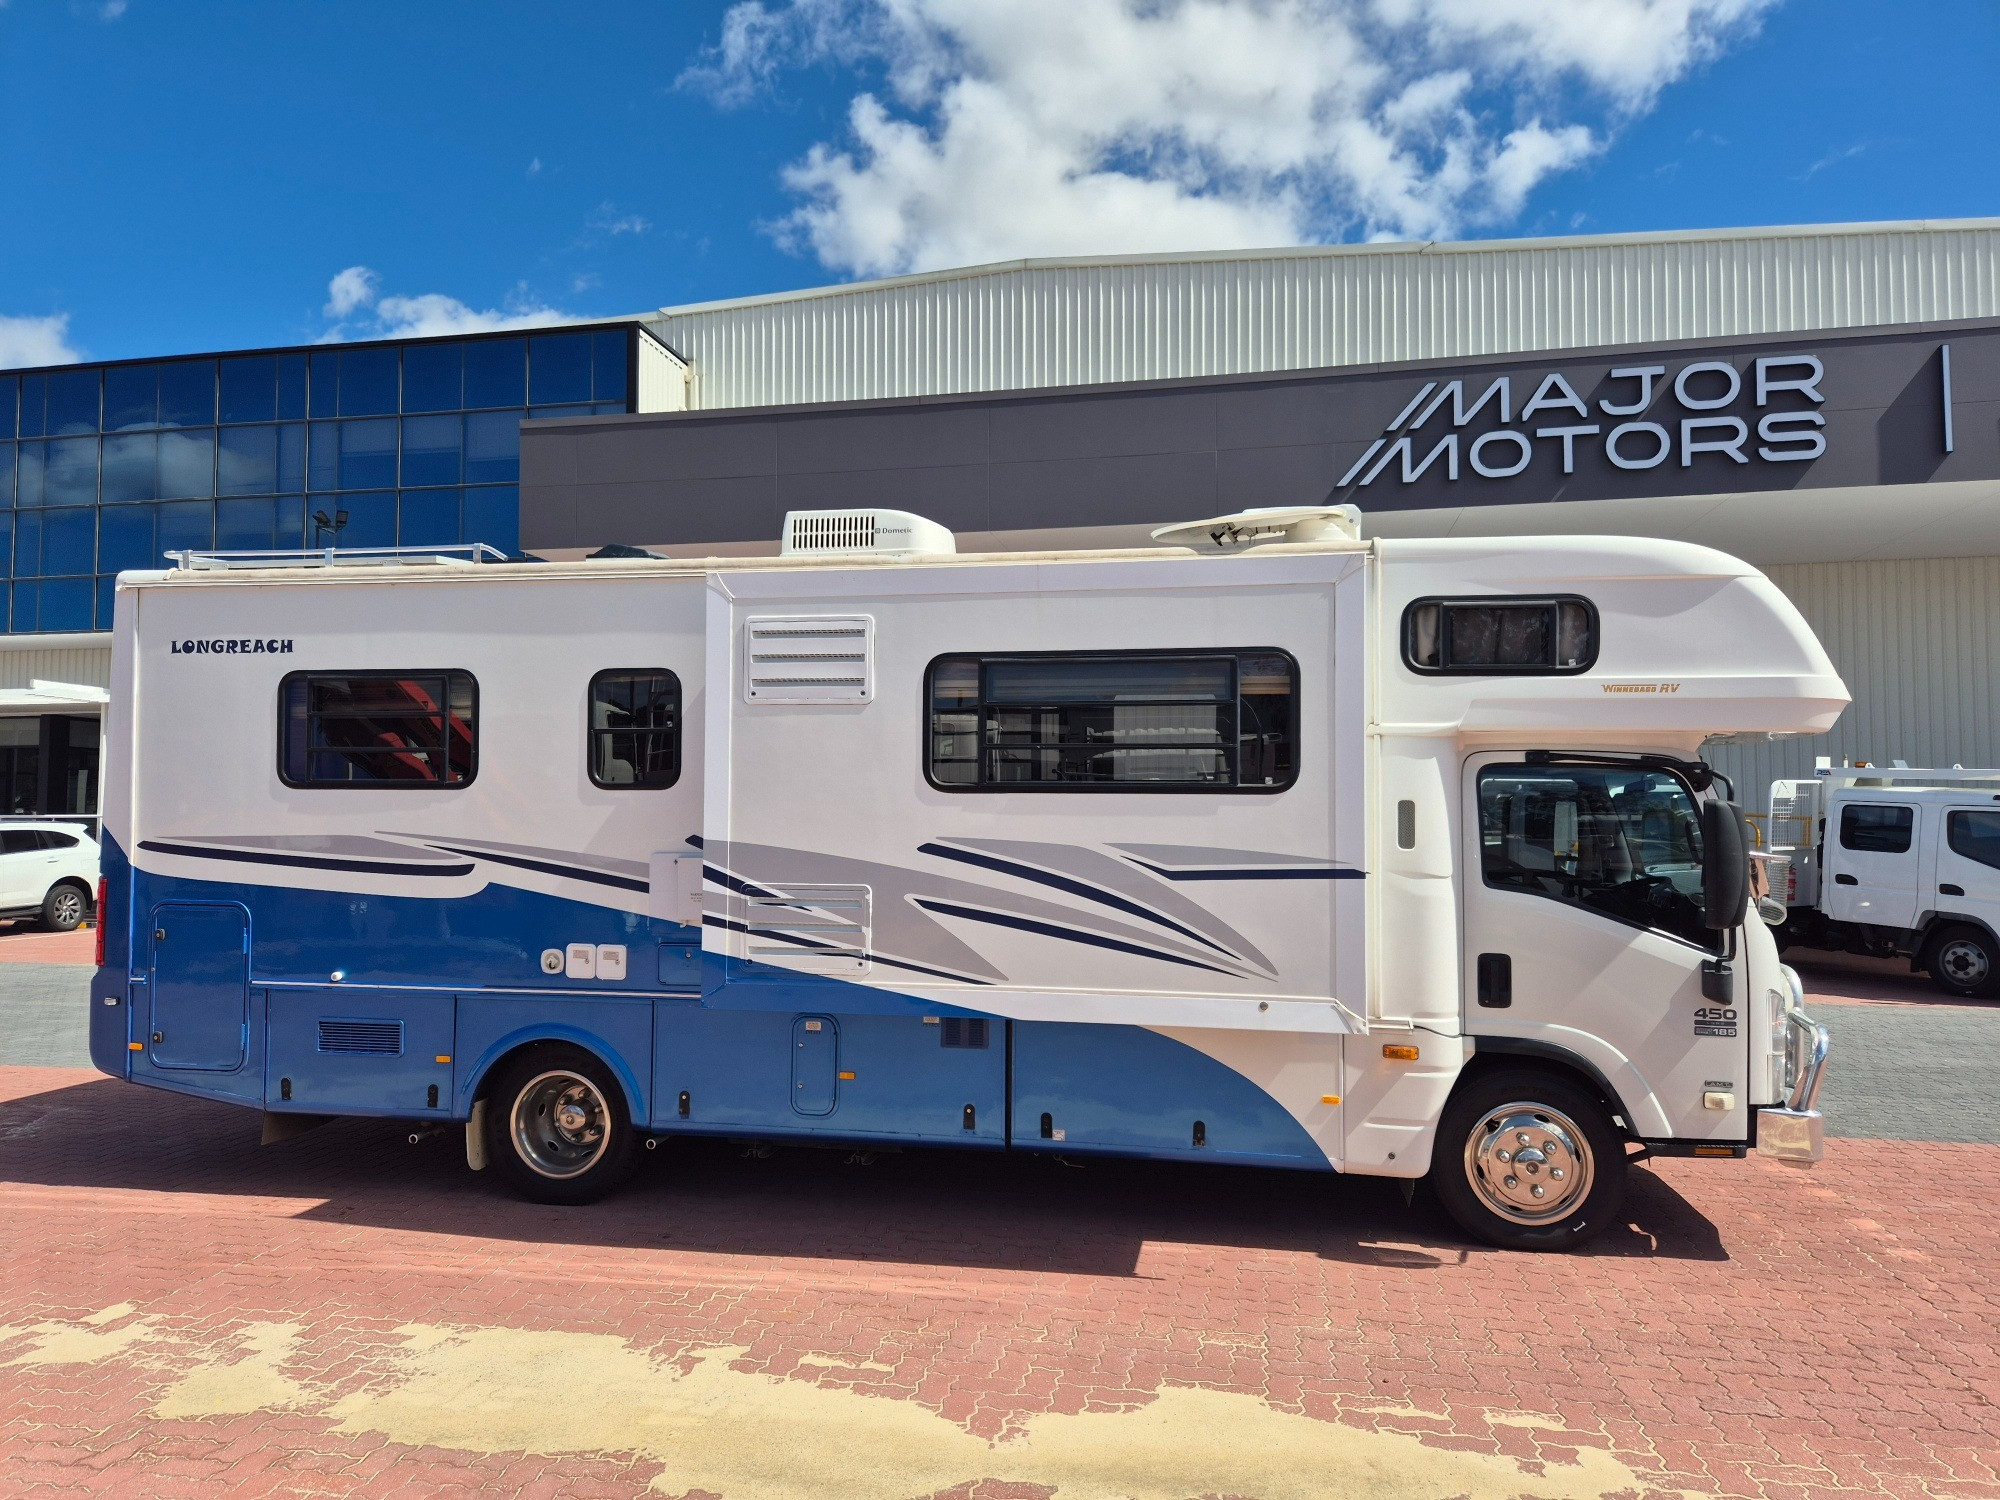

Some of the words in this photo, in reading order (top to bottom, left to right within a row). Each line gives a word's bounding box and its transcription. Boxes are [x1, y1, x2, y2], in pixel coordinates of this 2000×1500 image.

[1387, 355, 1826, 431] MAJOR
[1336, 411, 1827, 487] MOTORS
[171, 639, 294, 654] LONGREACH
[1601, 684, 1657, 693] WINNEBAGO
[1660, 683, 1681, 693] RV
[1694, 1008, 1737, 1020] 450
[1713, 1028, 1736, 1036] 185
